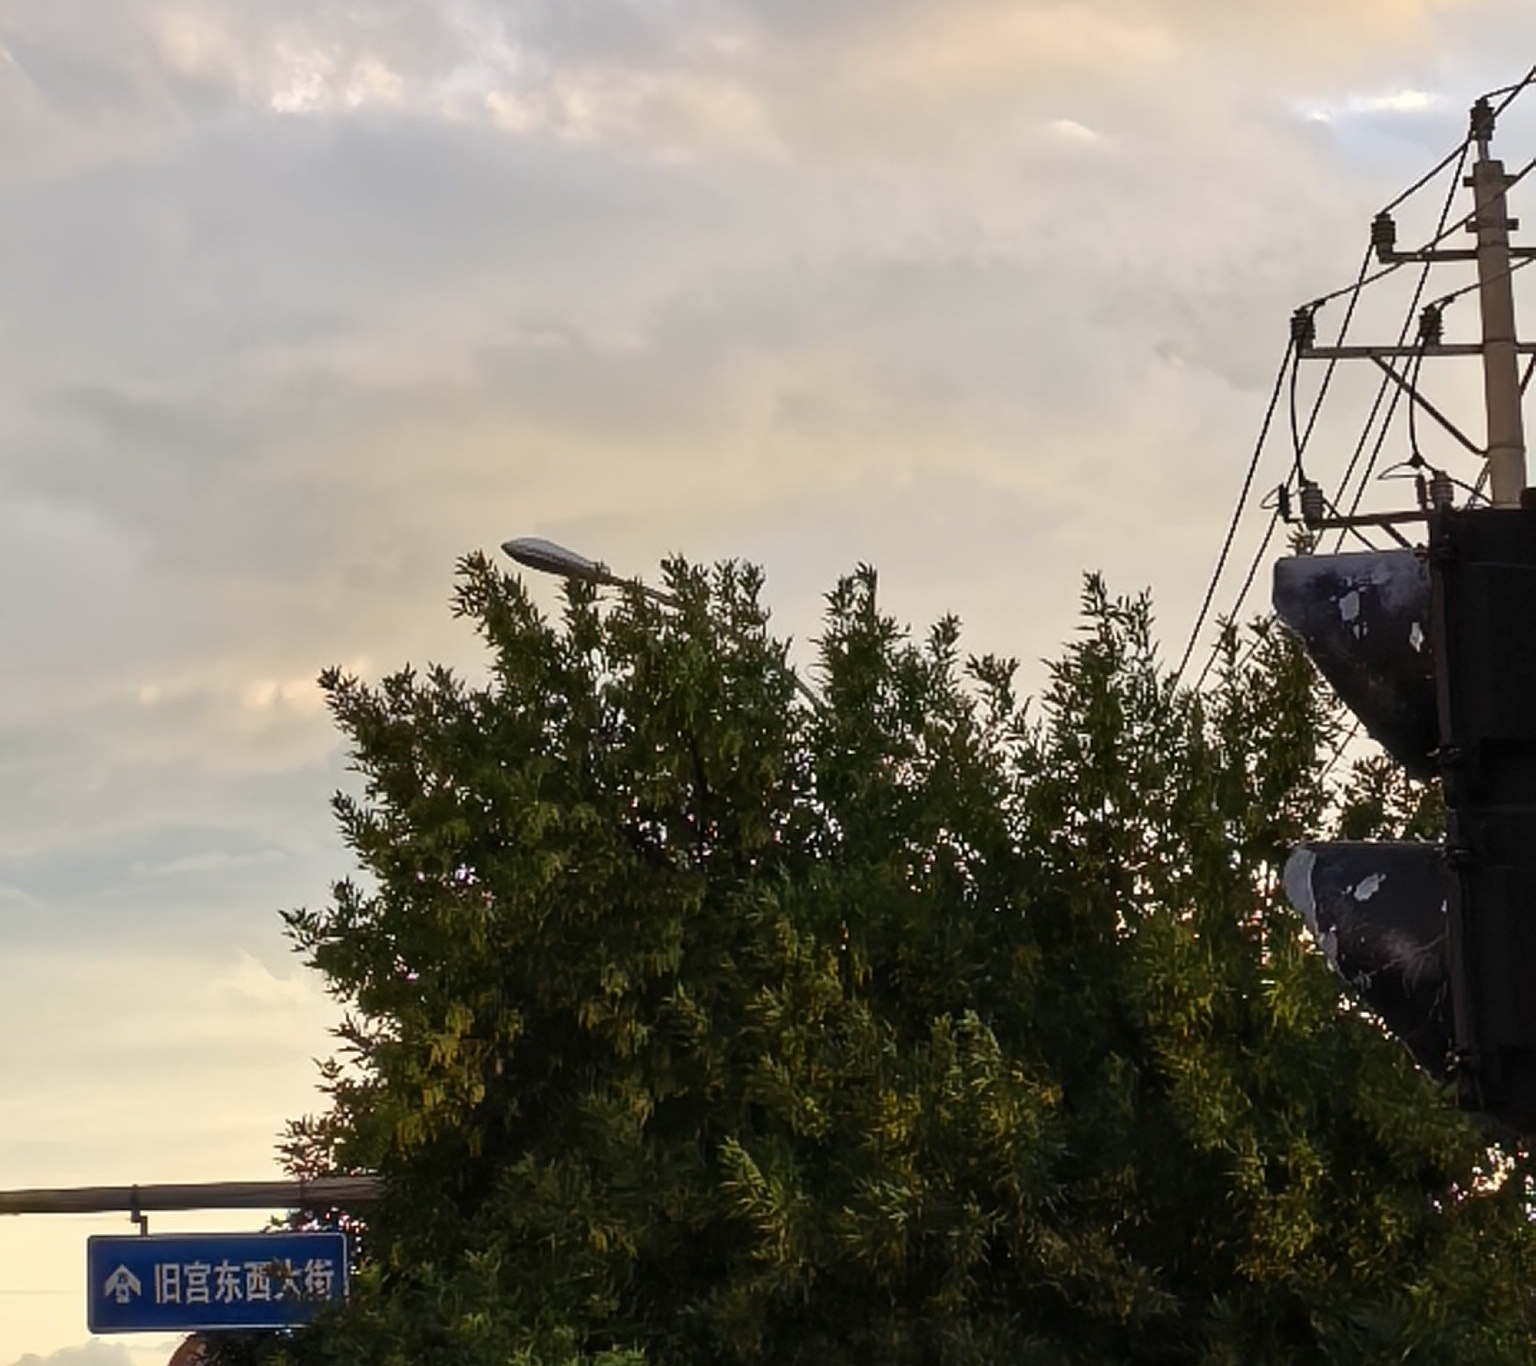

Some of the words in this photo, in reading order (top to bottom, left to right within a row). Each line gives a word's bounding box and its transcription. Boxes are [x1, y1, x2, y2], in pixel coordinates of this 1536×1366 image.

[154, 1258, 335, 1304] 旧宫东西大街
